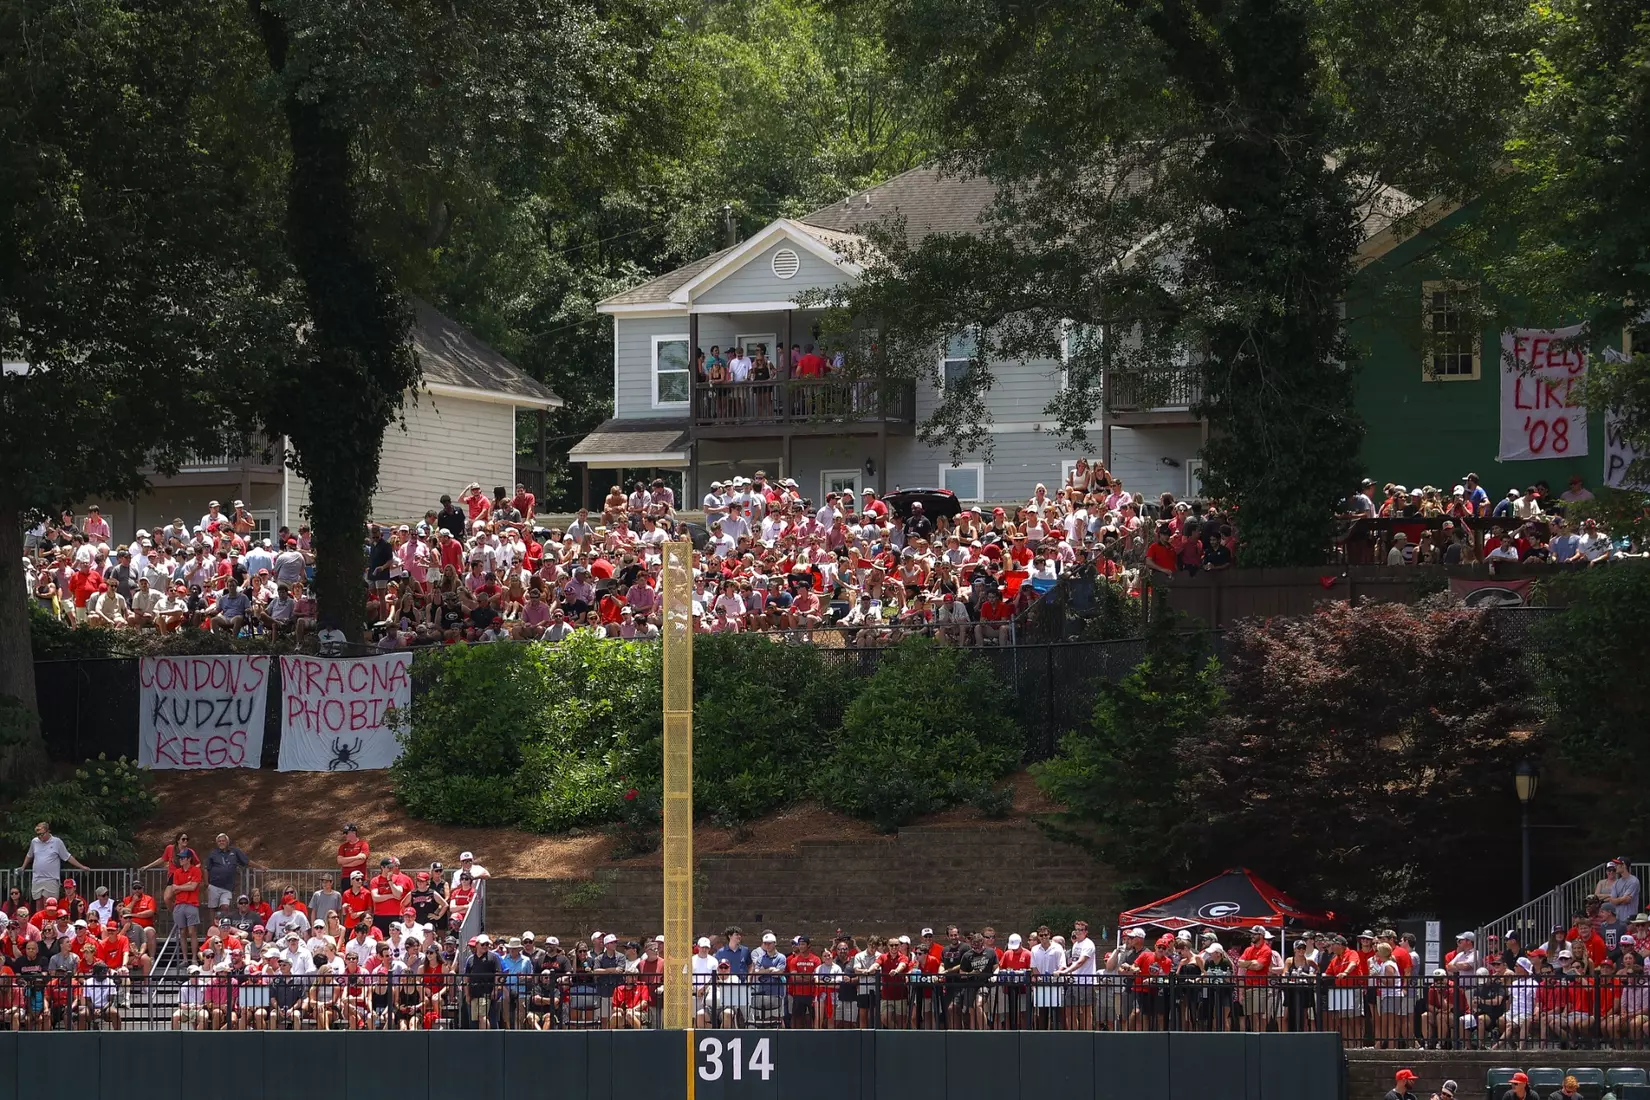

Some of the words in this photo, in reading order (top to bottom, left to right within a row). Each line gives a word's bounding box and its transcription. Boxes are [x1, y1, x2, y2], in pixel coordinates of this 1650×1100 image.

[1524, 416, 1569, 454] '08
[280, 656, 408, 697] MRACNA
[152, 694, 254, 729] KUDZU
[155, 730, 248, 766] KEGS
[698, 1037, 774, 1081] 314
